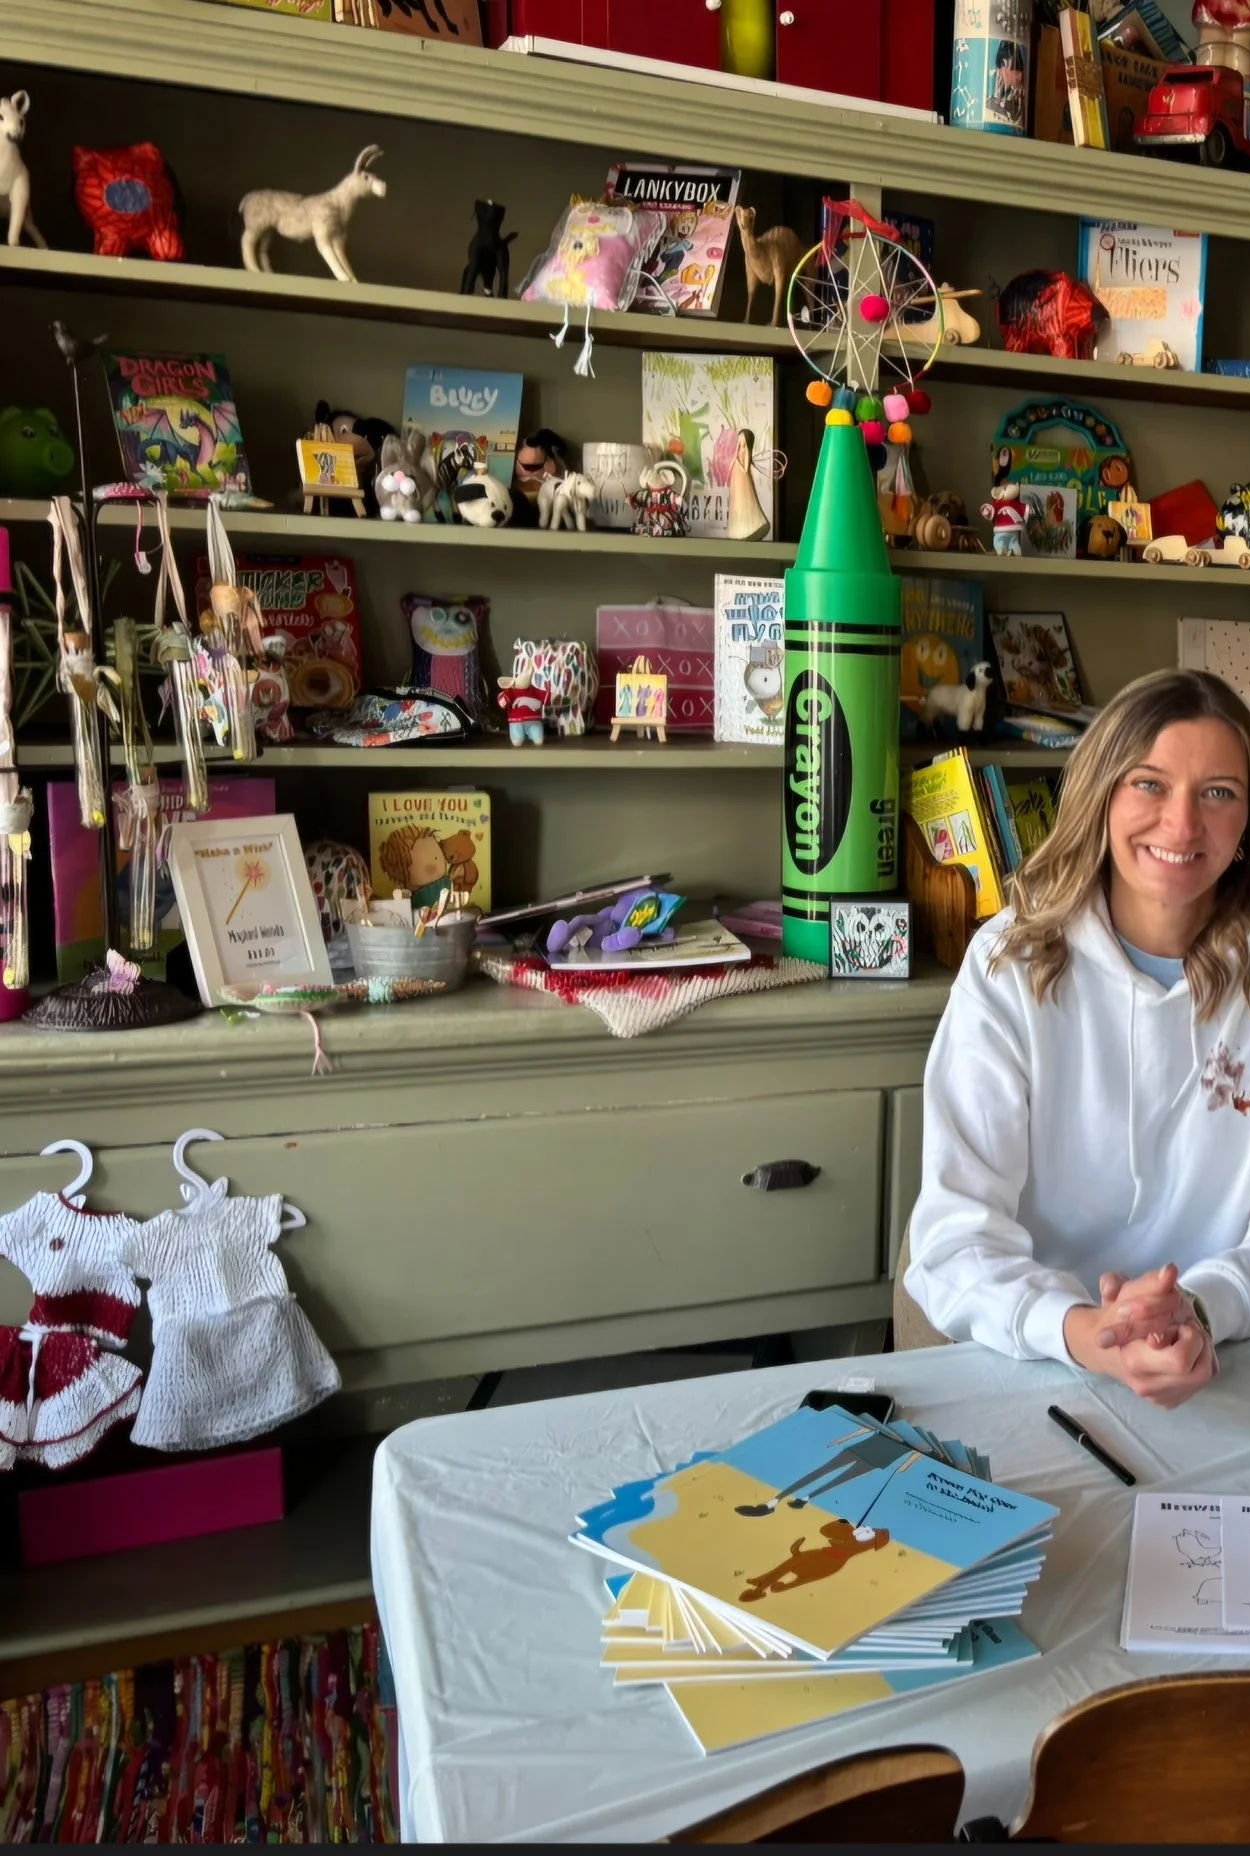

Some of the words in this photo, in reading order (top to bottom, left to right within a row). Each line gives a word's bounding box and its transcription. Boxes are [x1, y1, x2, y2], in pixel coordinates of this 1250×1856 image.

[623, 177, 722, 202] LANKYBOX
[117, 356, 218, 383] DRAGON
[131, 374, 210, 399] GIRLS
[788, 687, 834, 861] Crayon
[438, 798, 468, 812] YOU
[869, 798, 897, 878] green
